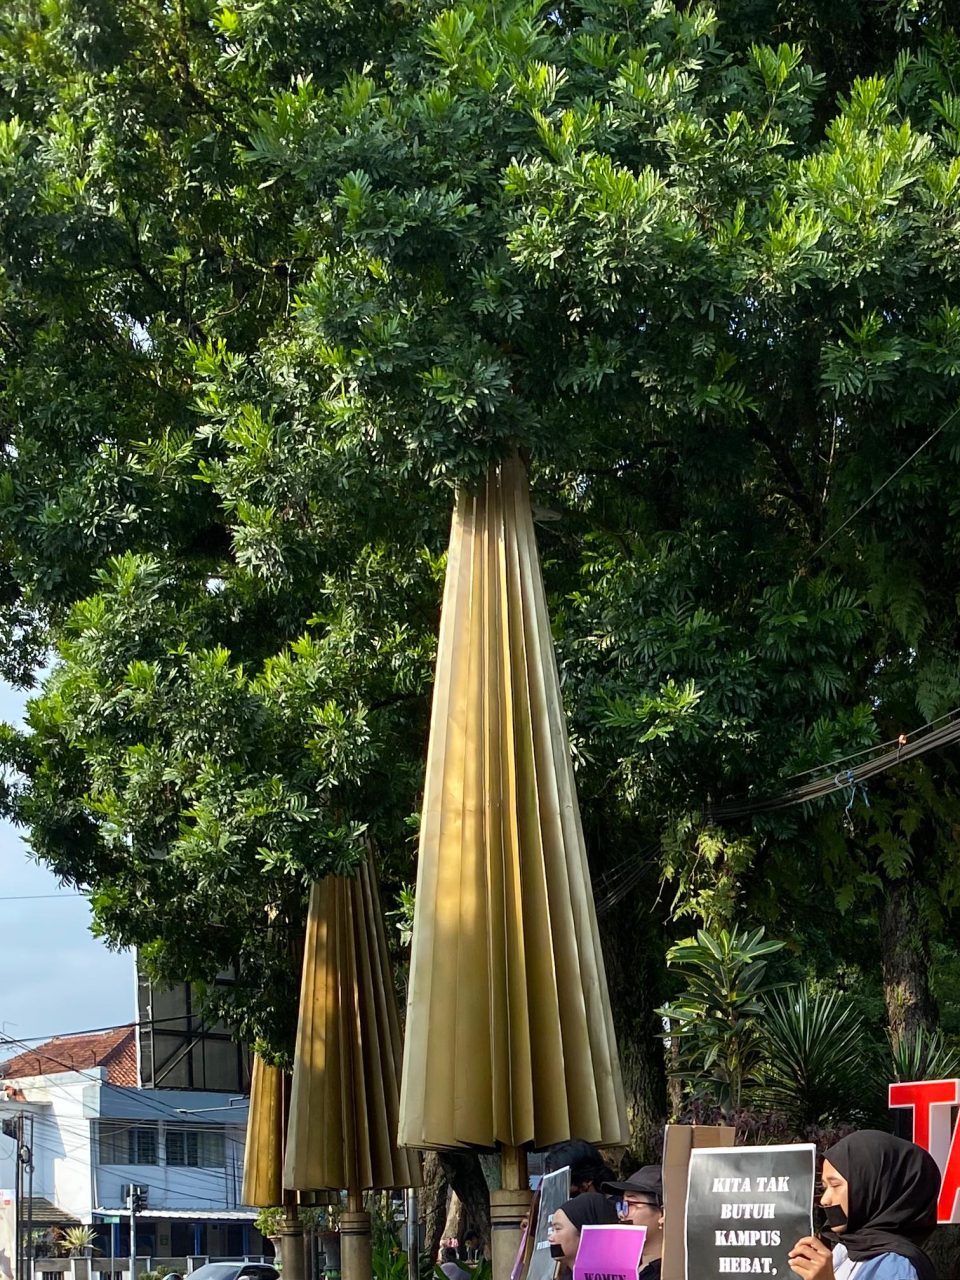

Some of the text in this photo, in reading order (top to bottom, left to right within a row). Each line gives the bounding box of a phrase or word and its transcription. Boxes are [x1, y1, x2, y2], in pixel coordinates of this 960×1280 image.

[712, 1176, 789, 1192] KITA TAK
[721, 1203, 776, 1219] BUTUH
[715, 1231, 780, 1246] KAMPUS
[719, 1258, 777, 1275] HEBAT,
